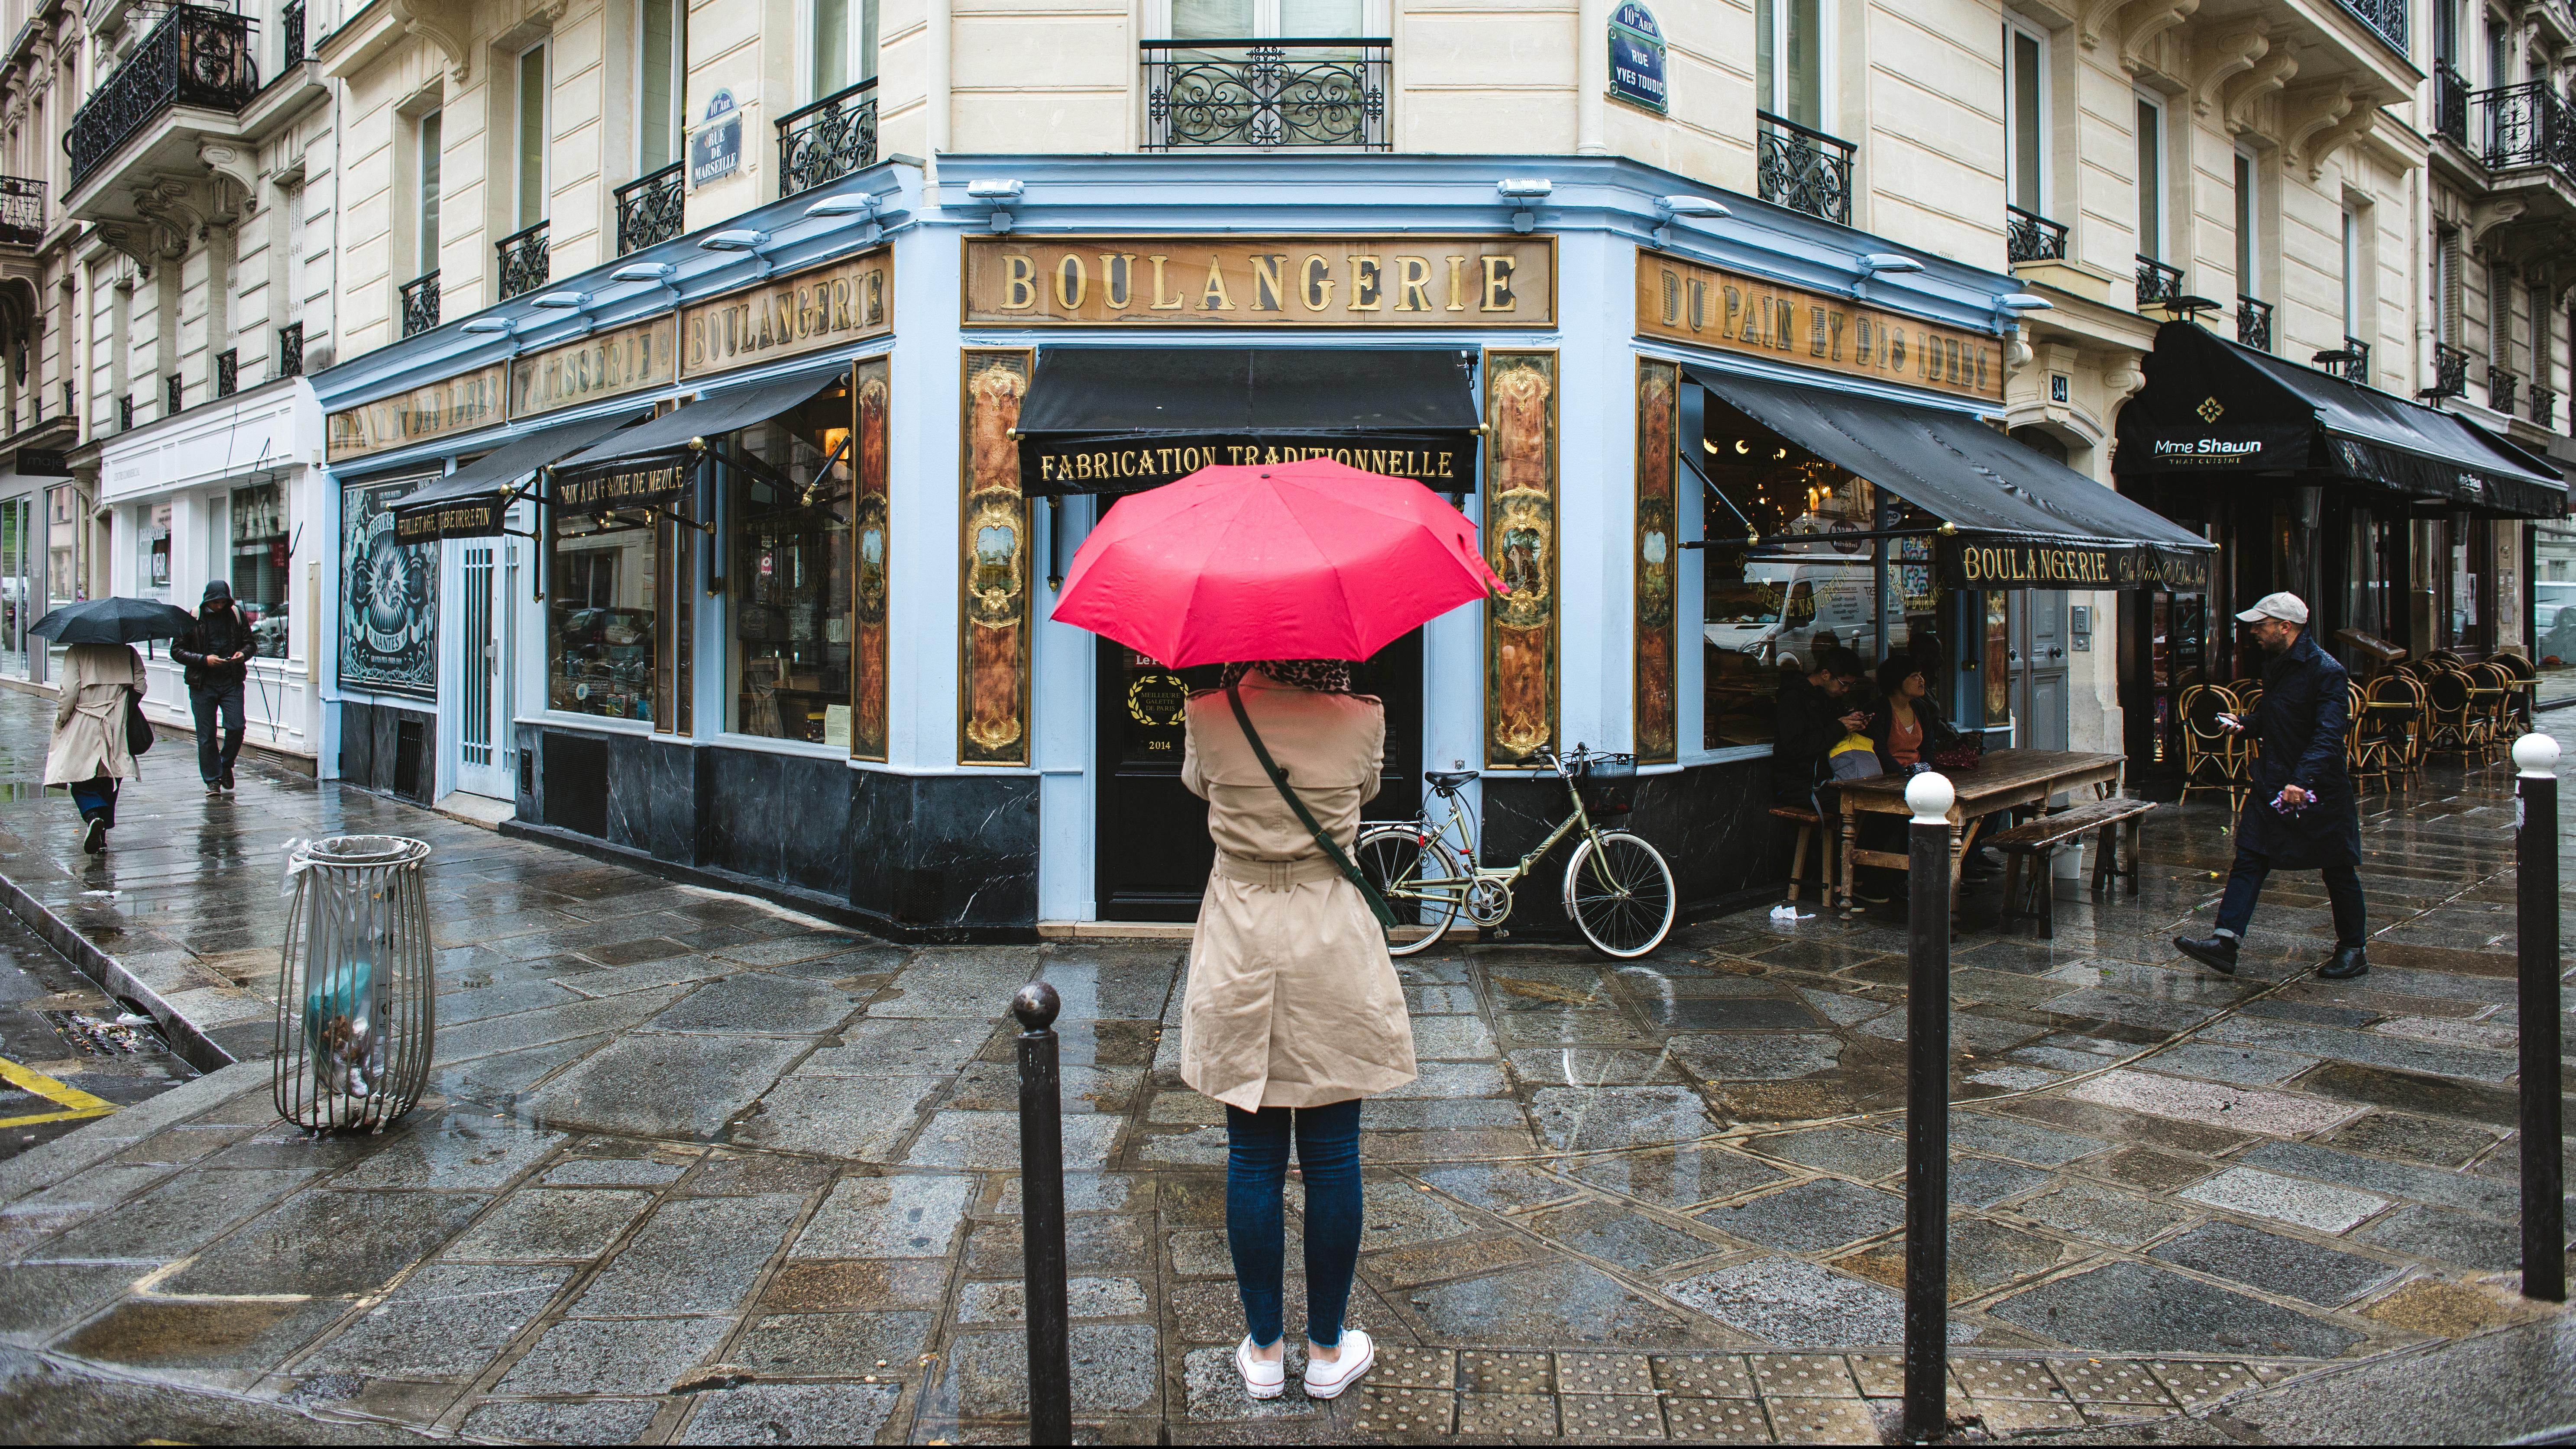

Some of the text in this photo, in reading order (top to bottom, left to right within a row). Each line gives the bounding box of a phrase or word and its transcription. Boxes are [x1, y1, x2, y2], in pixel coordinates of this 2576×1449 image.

[1631, 49, 1649, 67] RUE
[1616, 66, 1663, 96] YVES TOUDIC
[709, 127, 725, 148] RUE
[711, 145, 722, 160] DE
[695, 152, 736, 182] MARSEILLE
[1000, 252, 1517, 313] BOULANGERIE
[690, 269, 883, 365] BOULANGERIE
[1662, 270, 1707, 332] DU
[1722, 285, 1795, 351] PAIN
[1810, 306, 1844, 362] ET
[1856, 317, 1906, 372] DES
[2053, 377, 2065, 401] 34
[2155, 438, 2261, 453] Mme Shawn
[27, 456, 65, 471] maje
[1041, 445, 1453, 481] FABRICATION TRADITIONNELLE
[561, 483, 578, 504] PAIN
[580, 482, 586, 503] A
[588, 480, 598, 501] LA
[632, 472, 645, 495] DE
[648, 466, 683, 493] MEULE
[444, 509, 475, 529] BEURRE
[476, 507, 490, 527] FIN
[139, 526, 166, 547] patagonia
[139, 552, 166, 577] WORN WEAR
[1963, 547, 2110, 582] BOULANGERIE
[1755, 579, 1795, 617] PIERRE
[1799, 560, 1854, 617] NATURELLE
[373, 633, 400, 651] NANTES
[1136, 655, 1150, 665] Le
[1149, 741, 1171, 750] 2014
[1552, 812, 1577, 838] MOTOBECANE
